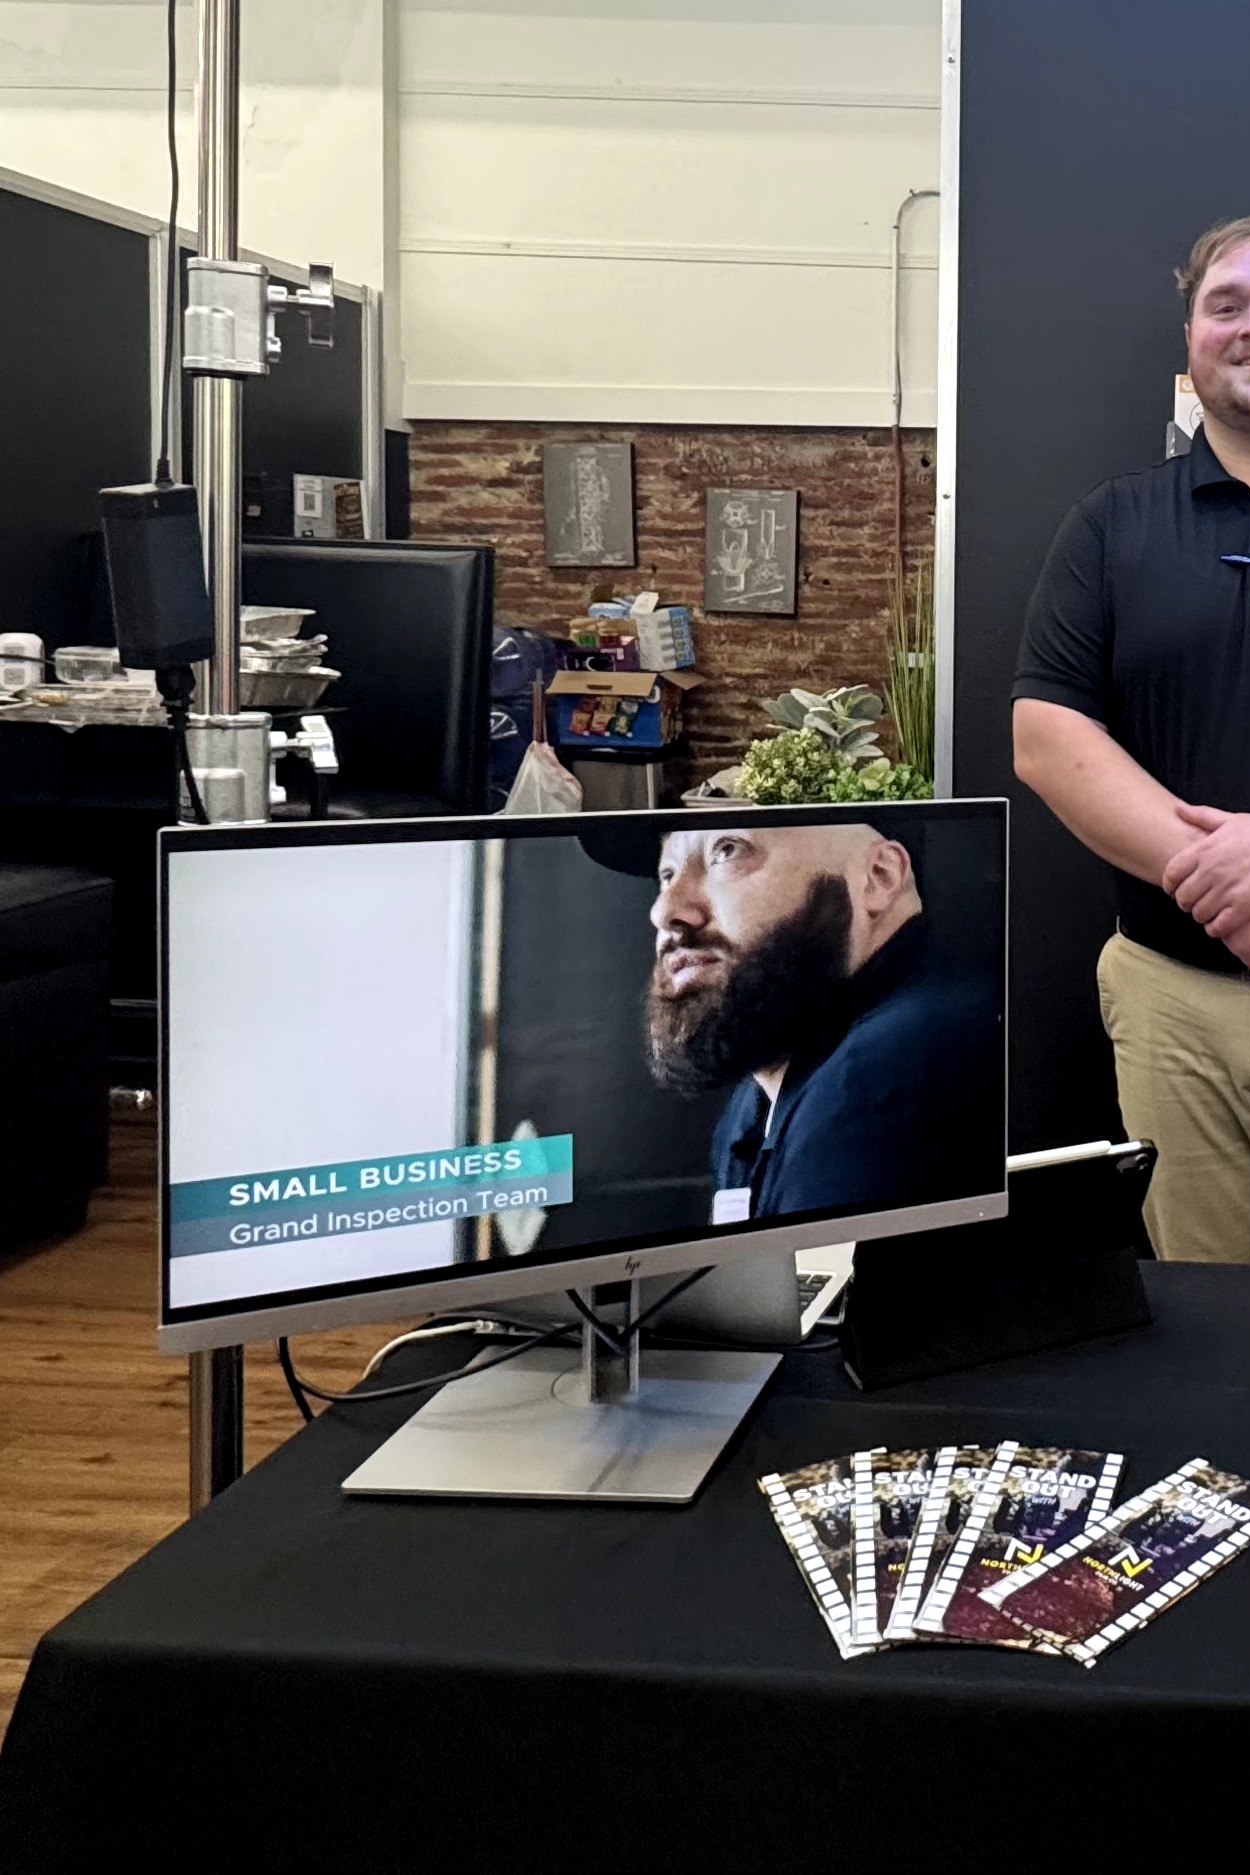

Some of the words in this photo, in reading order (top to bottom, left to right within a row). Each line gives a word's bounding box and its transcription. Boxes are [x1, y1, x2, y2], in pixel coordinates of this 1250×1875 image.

[229, 1172, 348, 1206] SMALL
[360, 1149, 523, 1189] BUSINESS
[229, 1213, 318, 1245] Grand
[328, 1197, 468, 1232] Inspection
[476, 1186, 548, 1210] Team
[625, 1256, 641, 1276] hp
[1009, 1465, 1097, 1489] STAND
[1021, 1481, 1077, 1498] OUT
[1176, 1499, 1227, 1525] OUT
[1082, 1556, 1145, 1592] NORTHLIGHT
